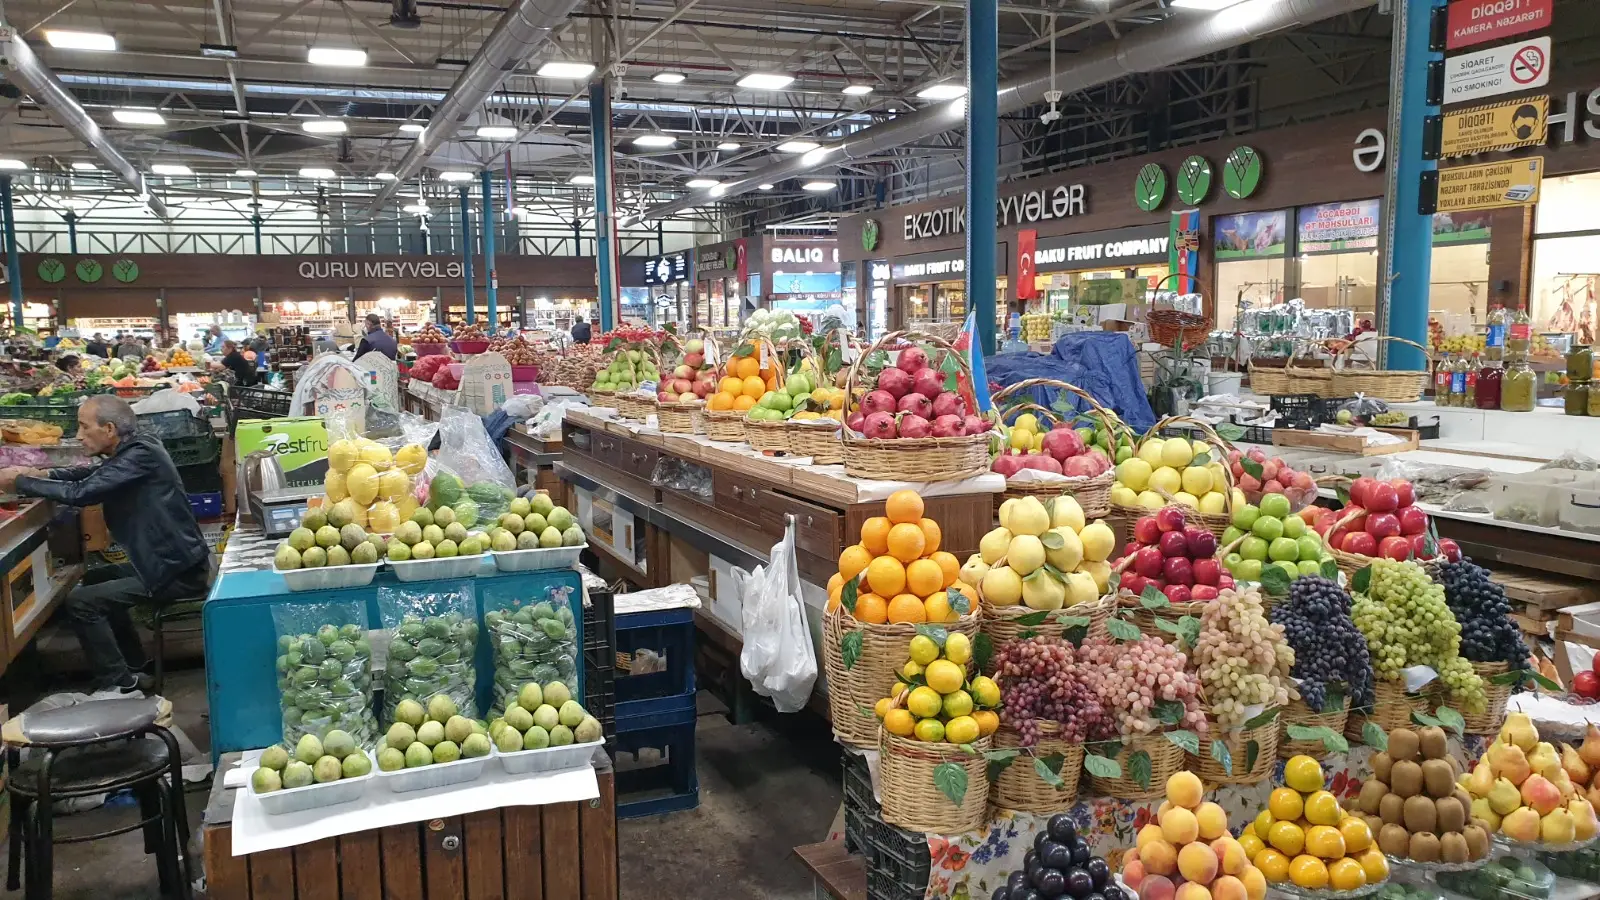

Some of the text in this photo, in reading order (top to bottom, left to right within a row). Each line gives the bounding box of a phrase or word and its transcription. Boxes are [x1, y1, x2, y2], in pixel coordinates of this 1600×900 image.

[1454, 22, 1492, 38] KAMERA
[1451, 78, 1502, 94] NO SMOKING!
[1458, 112, 1494, 129] DİQQƏT!
[1441, 168, 1483, 182] MƏHSULLARIN
[1440, 184, 1467, 195] NƏZARƏT
[996, 184, 1085, 226] YVƏLƏR
[1439, 196, 1466, 208] YOXLAYA
[1305, 216, 1373, 231] ƏT MƏHSULLARI
[771, 247, 824, 263] BALIQ
[1034, 236, 1170, 264] BAKU FRUIT COMPANY
[298, 261, 358, 279] QURU
[286, 478, 319, 488] citrus
